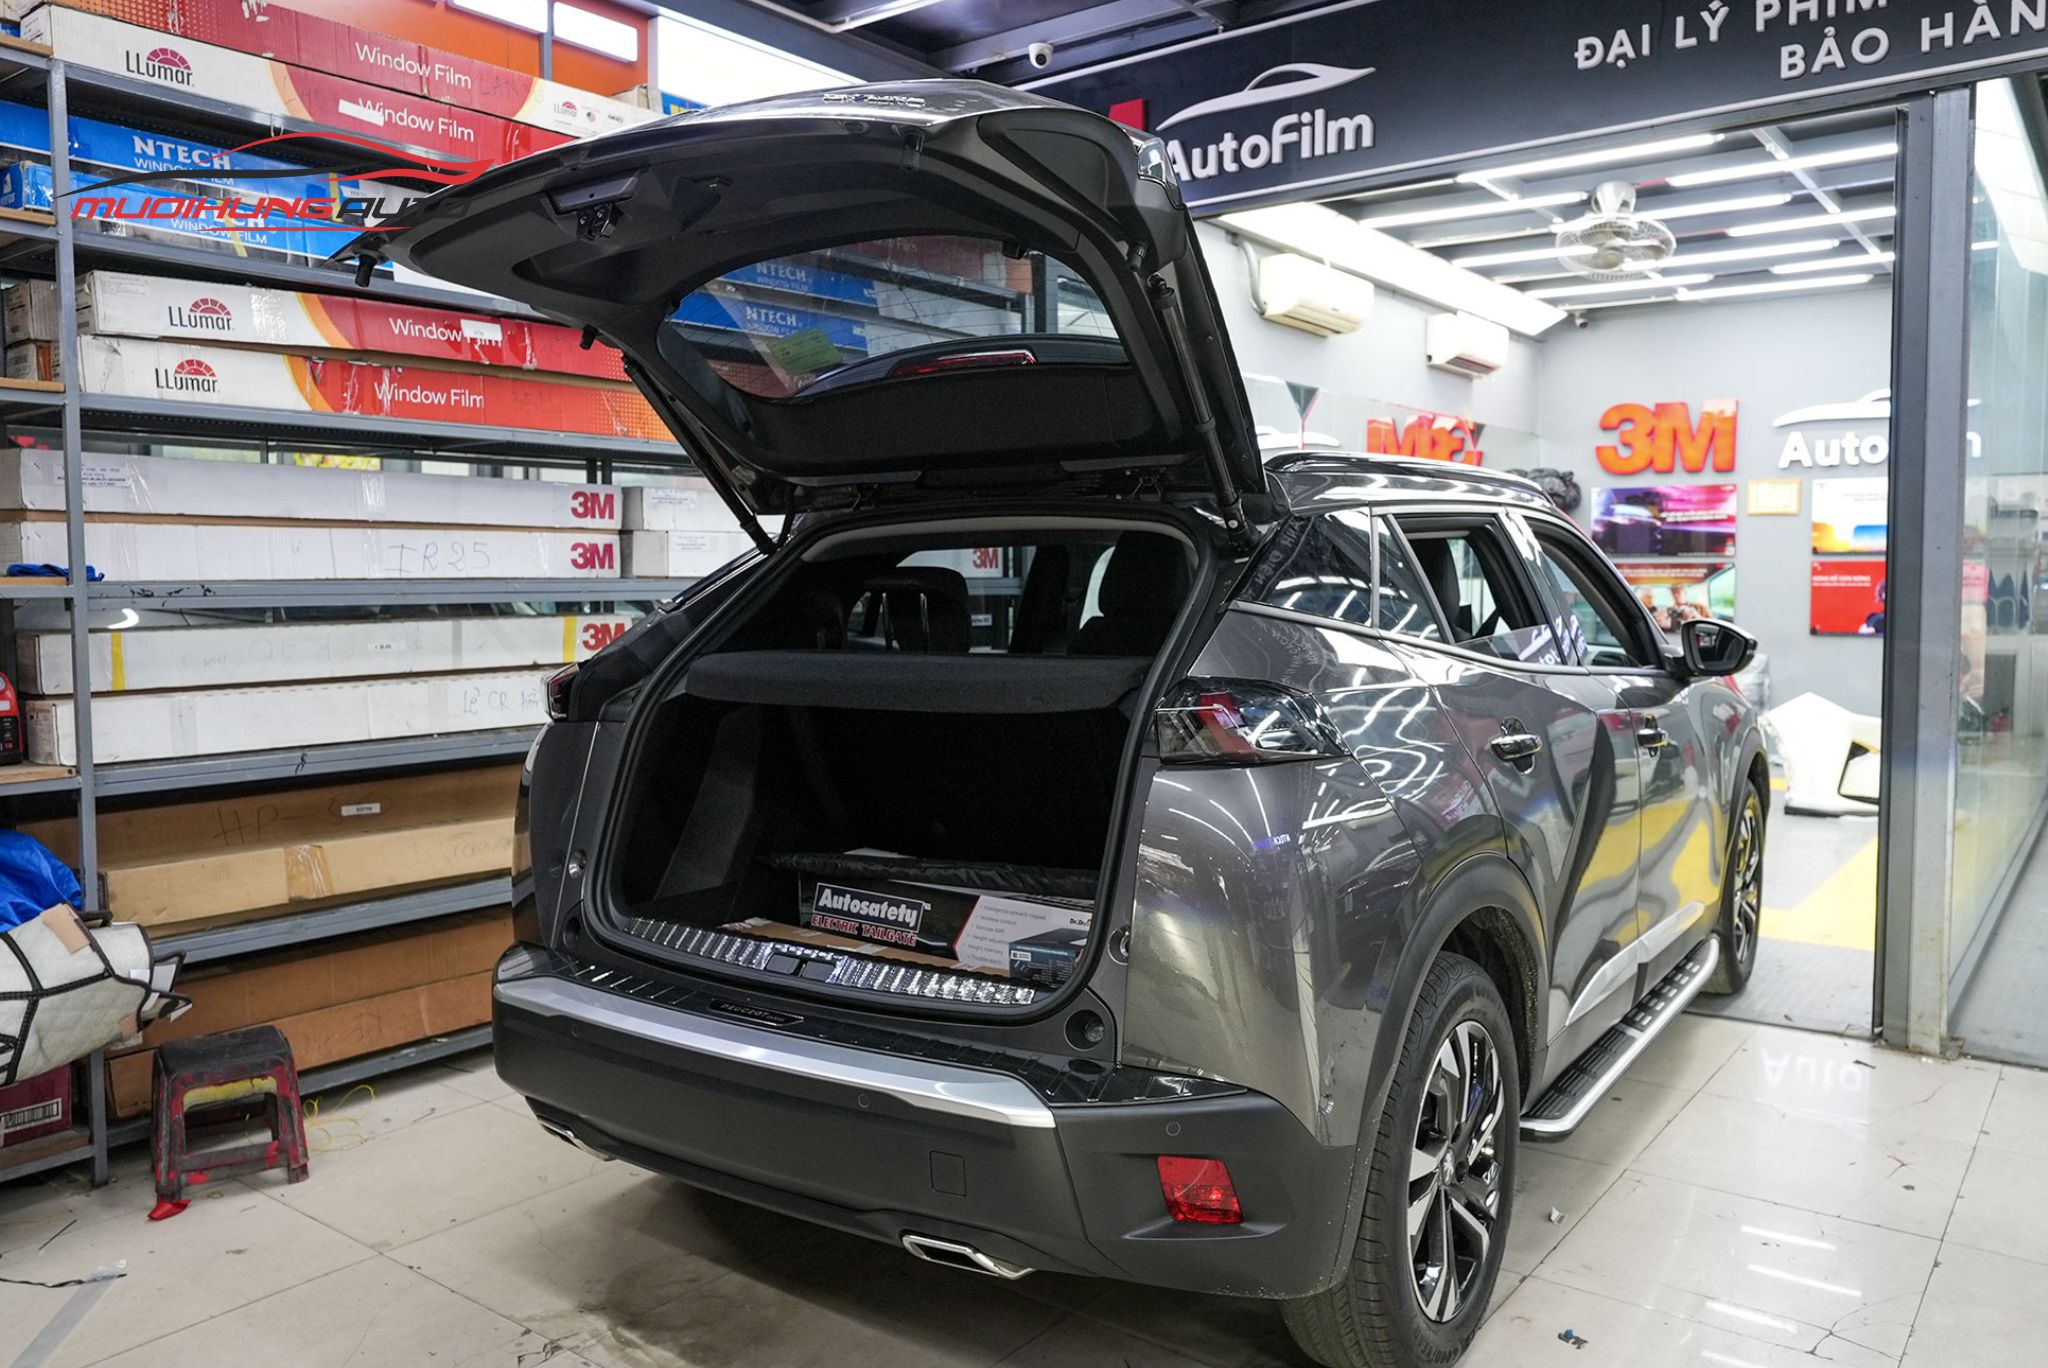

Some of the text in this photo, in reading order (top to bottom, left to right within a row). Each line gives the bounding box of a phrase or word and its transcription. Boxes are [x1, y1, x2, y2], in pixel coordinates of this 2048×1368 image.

[1574, 23, 1651, 70] ĐẠI
[1675, 0, 1731, 49] LÝ
[126, 50, 193, 87] LLumar
[355, 42, 431, 78] Window
[435, 63, 472, 90] Film
[1780, 26, 1890, 80] BẢO
[438, 117, 474, 142] Film
[132, 135, 231, 170] NTECH
[1166, 109, 1374, 182] AutoFilm
[168, 306, 232, 331] LLumar
[389, 318, 462, 342] Window
[155, 368, 218, 393] LLumar
[375, 383, 484, 408] Window Film
[1596, 400, 1738, 476] 3M
[571, 491, 615, 520] 3M
[571, 542, 614, 570] 3M
[972, 547, 999, 569] 3M
[582, 623, 626, 651] 3M
[818, 888, 918, 927] Autosafety
[811, 914, 917, 947] ELECTRIC TAILGATE
